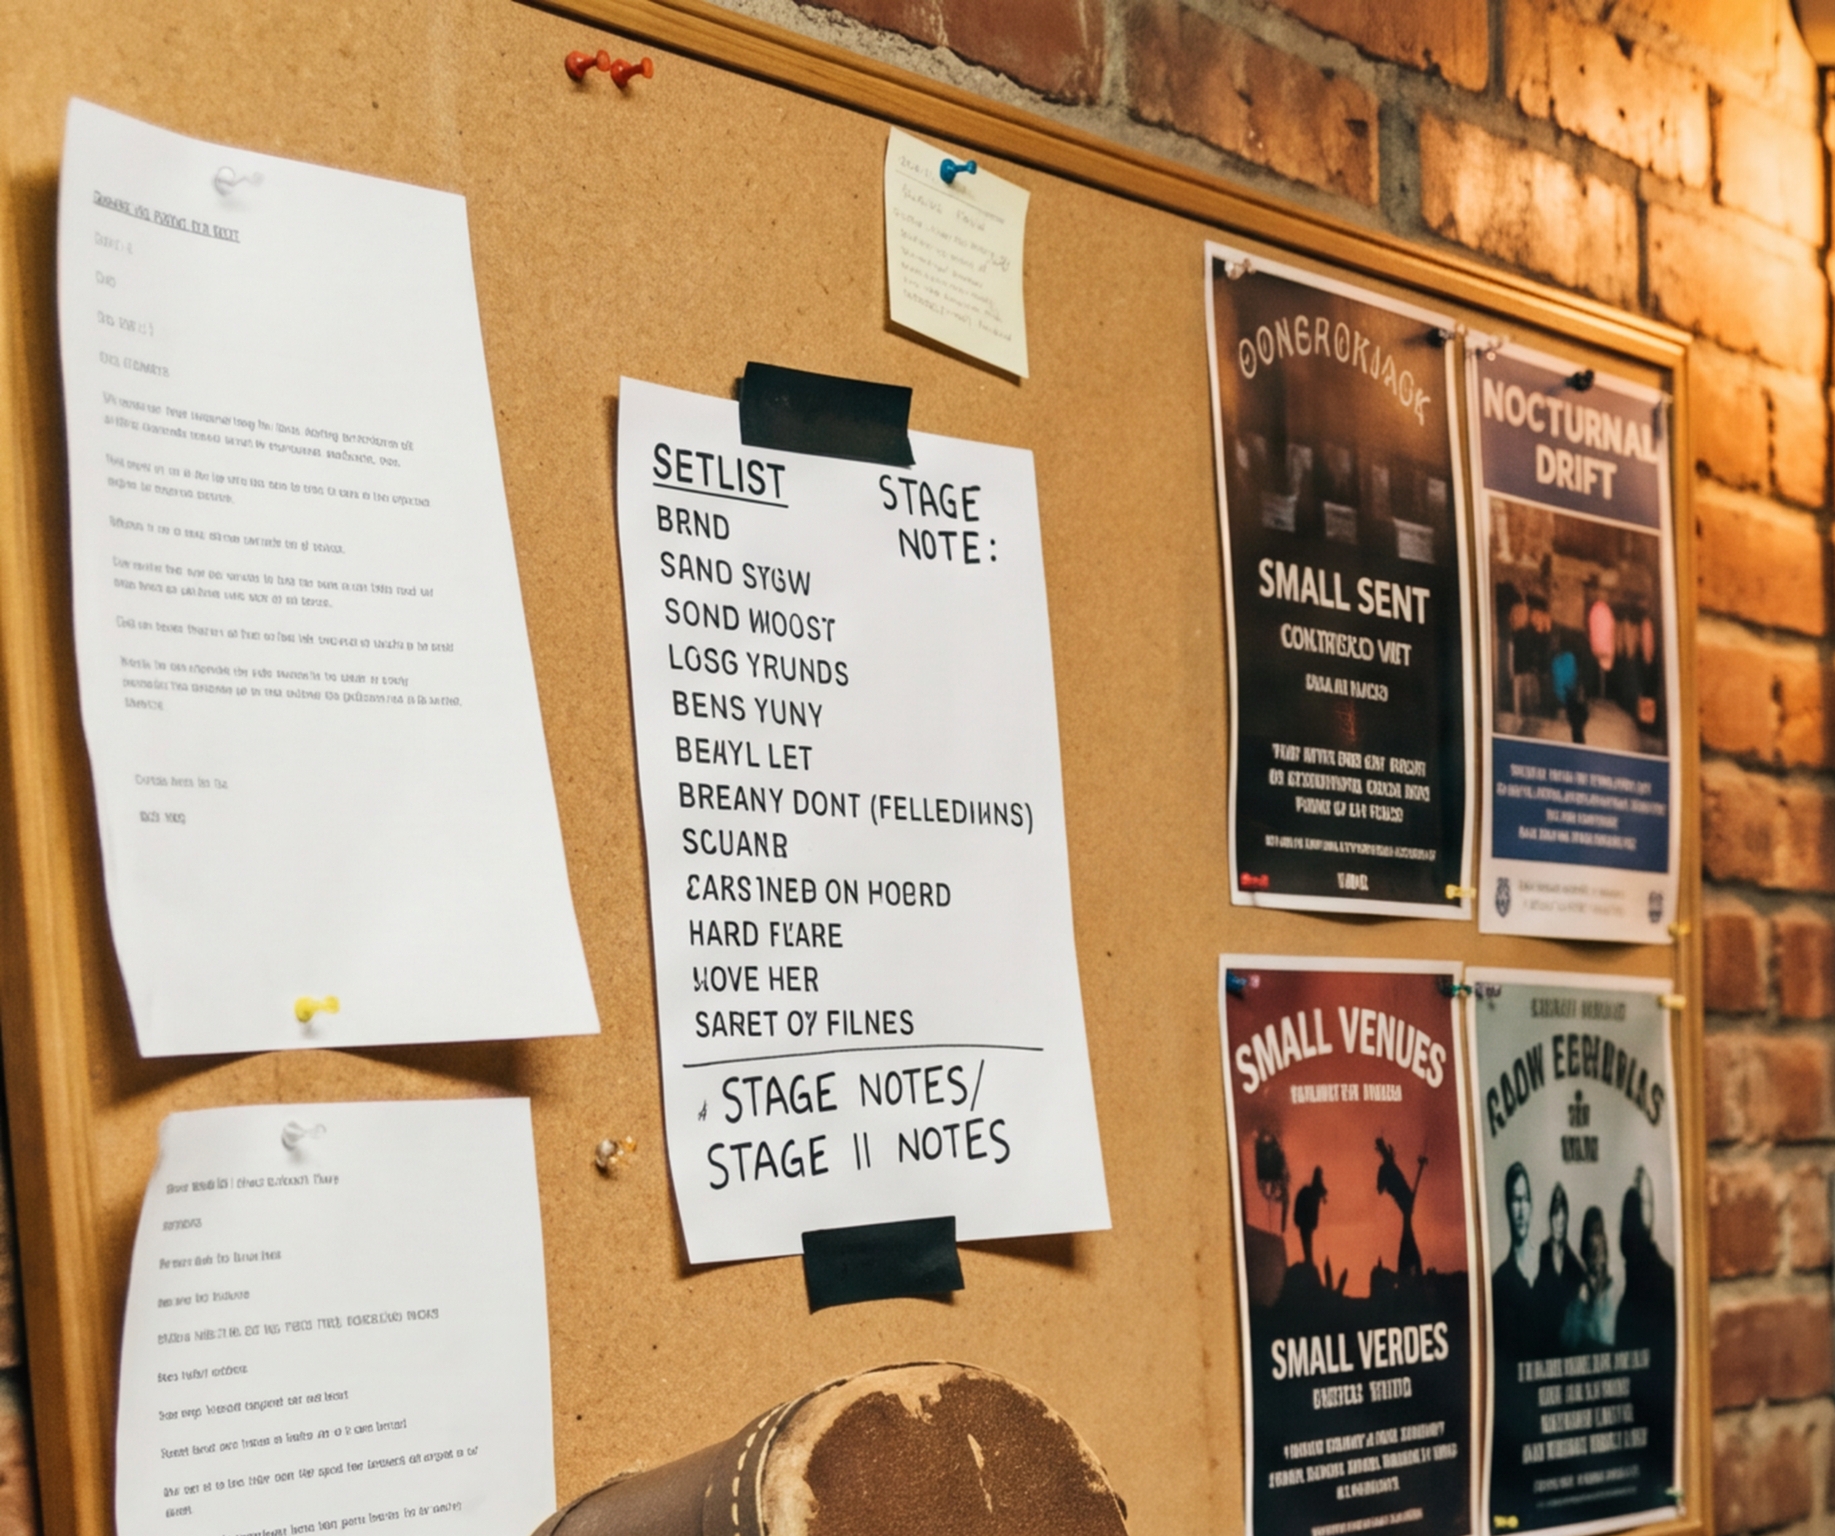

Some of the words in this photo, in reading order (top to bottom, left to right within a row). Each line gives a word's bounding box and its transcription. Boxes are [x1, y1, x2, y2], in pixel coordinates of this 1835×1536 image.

[1482, 376, 1660, 464] NOCTURNAL
[652, 442, 787, 499] SETLIST
[1535, 443, 1618, 501] DRIFT
[878, 474, 981, 522] STAGE
[656, 504, 730, 541] BRND
[660, 550, 733, 585] SAND
[1259, 558, 1351, 611] SMALL
[1357, 577, 1430, 624] SENT
[664, 597, 740, 631] SOND
[668, 643, 739, 676] LOSG
[746, 651, 849, 687] YRUNDS
[672, 690, 746, 722] BENS
[754, 697, 823, 728] YUNY
[768, 743, 813, 771] LET
[678, 781, 784, 814] BREANY
[793, 789, 861, 818] DONT
[825, 878, 859, 905] ON
[689, 919, 759, 947] HARD
[768, 965, 819, 993] HER
[695, 1010, 779, 1038] SARET
[826, 1009, 915, 1037] FILNES
[1235, 1007, 1333, 1094] SMALL
[1338, 1005, 1447, 1088] VENUES
[722, 1071, 838, 1124] STAGE
[707, 1134, 829, 1191] STAGE
[898, 1117, 1011, 1165] NOTES
[1271, 1333, 1354, 1380] SMALL
[1357, 1321, 1449, 1370] VERDES
